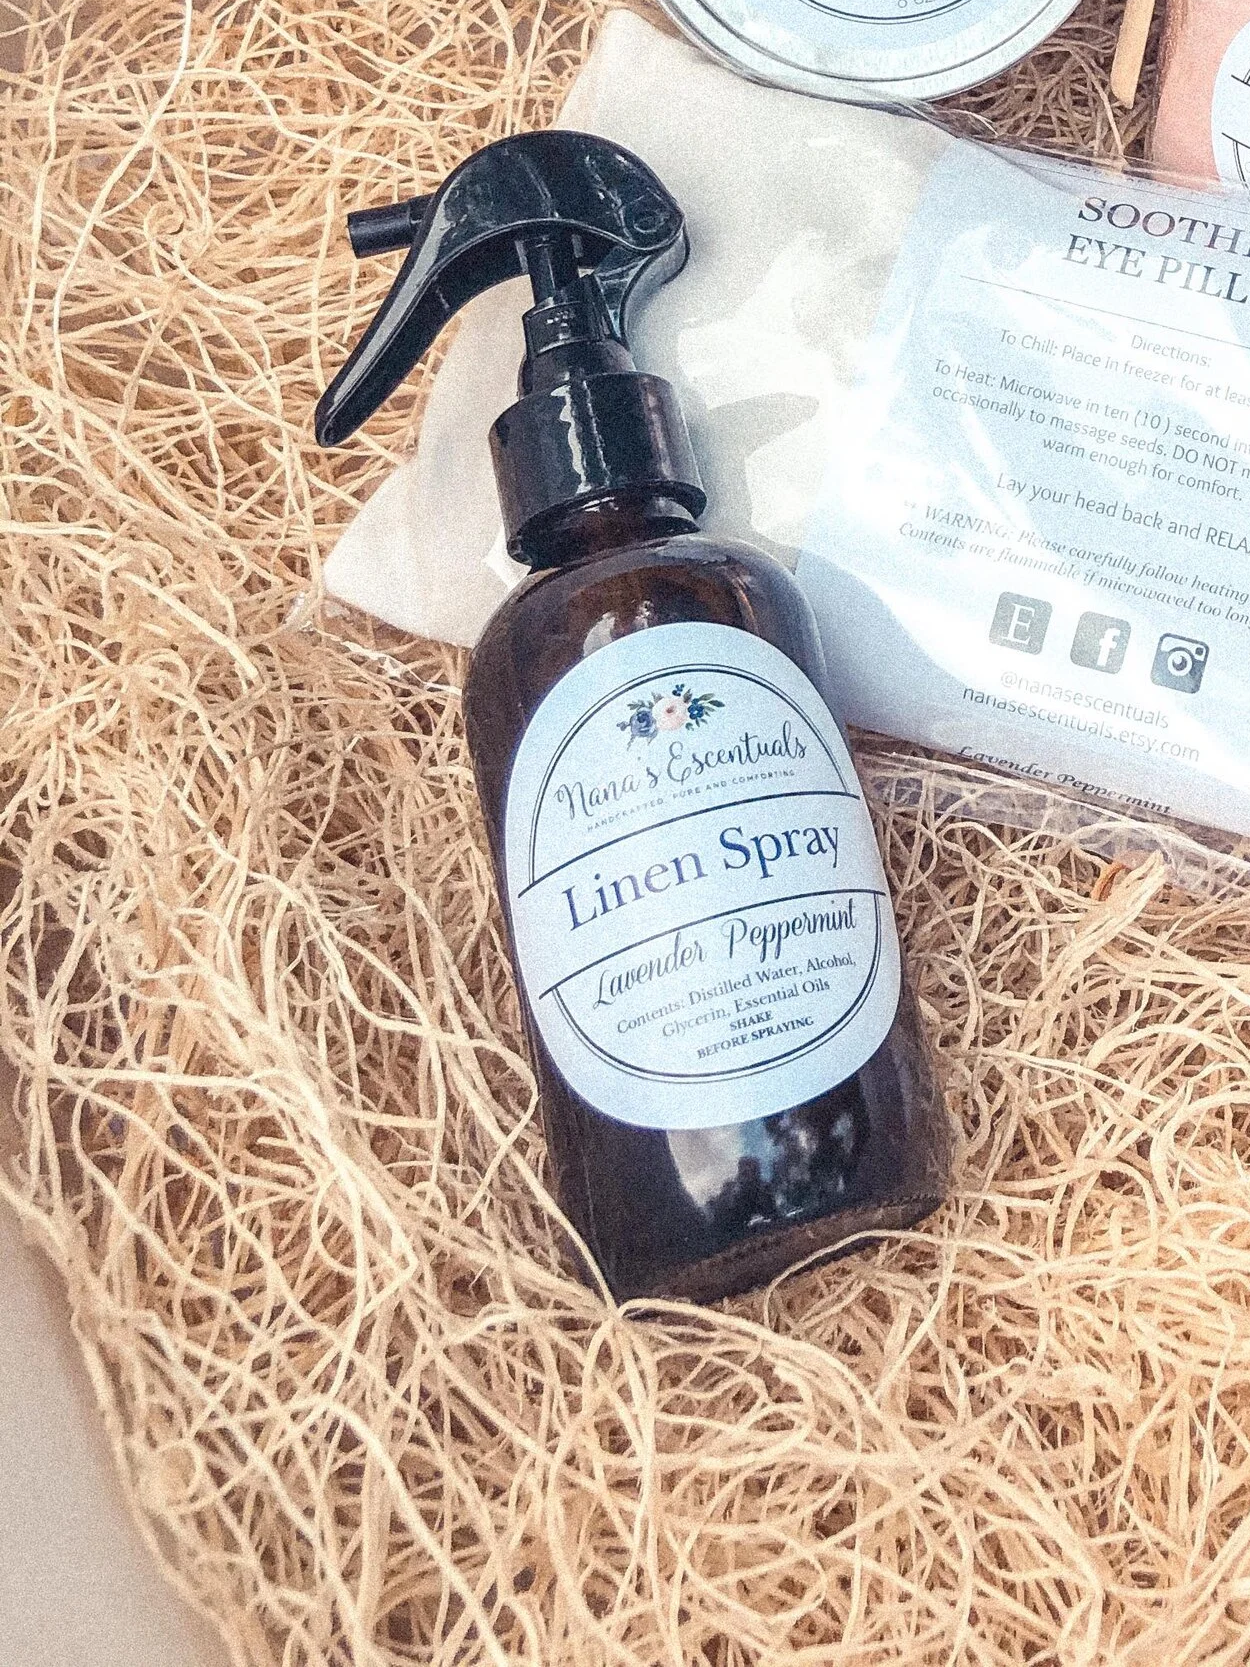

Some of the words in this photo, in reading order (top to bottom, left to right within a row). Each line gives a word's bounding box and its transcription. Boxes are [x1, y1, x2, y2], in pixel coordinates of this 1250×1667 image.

[1062, 233, 1146, 279] EYE
[999, 329, 1017, 346] To
[1021, 333, 1057, 357] Chill:
[1062, 344, 1101, 367] Place
[1122, 360, 1178, 386] freezer
[1180, 374, 1202, 393] for
[1205, 384, 1221, 400] at
[1130, 334, 1211, 368] Directions:
[932, 386, 1026, 422] occasionally
[1030, 409, 1046, 424] to
[1050, 417, 1117, 444] massage
[1120, 435, 1167, 456] seeds.
[1172, 445, 1199, 464] DO
[1202, 453, 1239, 475] NOT
[934, 358, 951, 376] To
[955, 363, 994, 387] Heat:
[999, 375, 1082, 410] Microwave
[1086, 398, 1099, 413] in
[1103, 402, 1129, 422] ten
[1174, 424, 1231, 449] second
[1043, 437, 1085, 458] warm
[1089, 449, 1148, 477] enough
[1152, 464, 1174, 481] for
[1177, 473, 1243, 502] comfort.
[996, 473, 1027, 496] Lay
[1029, 484, 1071, 504] your
[1075, 490, 1118, 517] head
[1122, 503, 1162, 530] back
[1168, 521, 1202, 541] and
[899, 521, 965, 550] Contents
[1083, 568, 1098, 586] if
[1098, 574, 1201, 610] microwaved
[1196, 600, 1221, 617] too
[1017, 529, 1066, 553] Please
[1069, 539, 1138, 575] carefully
[1137, 562, 1188, 584] follow
[1190, 574, 1250, 605] heating
[962, 686, 1200, 762] nanasescentuals.etsy.com
[1000, 670, 1169, 729] @nanasescentuals
[554, 756, 661, 820] Nana's
[667, 720, 807, 785] Escentuals
[672, 787, 701, 800] PURE
[705, 780, 727, 791] AND
[732, 769, 795, 785] COMFORTING
[957, 745, 1053, 779] Lavender
[1056, 773, 1172, 815] Peppermint
[562, 851, 708, 931] Linen
[719, 826, 839, 879] Spray
[592, 931, 708, 1010] Lavender
[720, 897, 858, 964] Peppermint
[617, 998, 687, 1034] Contents:
[688, 974, 752, 1006] Distilled
[755, 963, 803, 985] Water,
[805, 952, 857, 973] Alcohol,
[662, 1008, 731, 1038] Glycerin,
[733, 985, 800, 1014] Essential
[802, 978, 830, 994] Oils
[729, 1010, 773, 1031] SHAKE
[696, 1034, 749, 1060] BEFORE
[751, 1015, 814, 1041] SPRAYING
